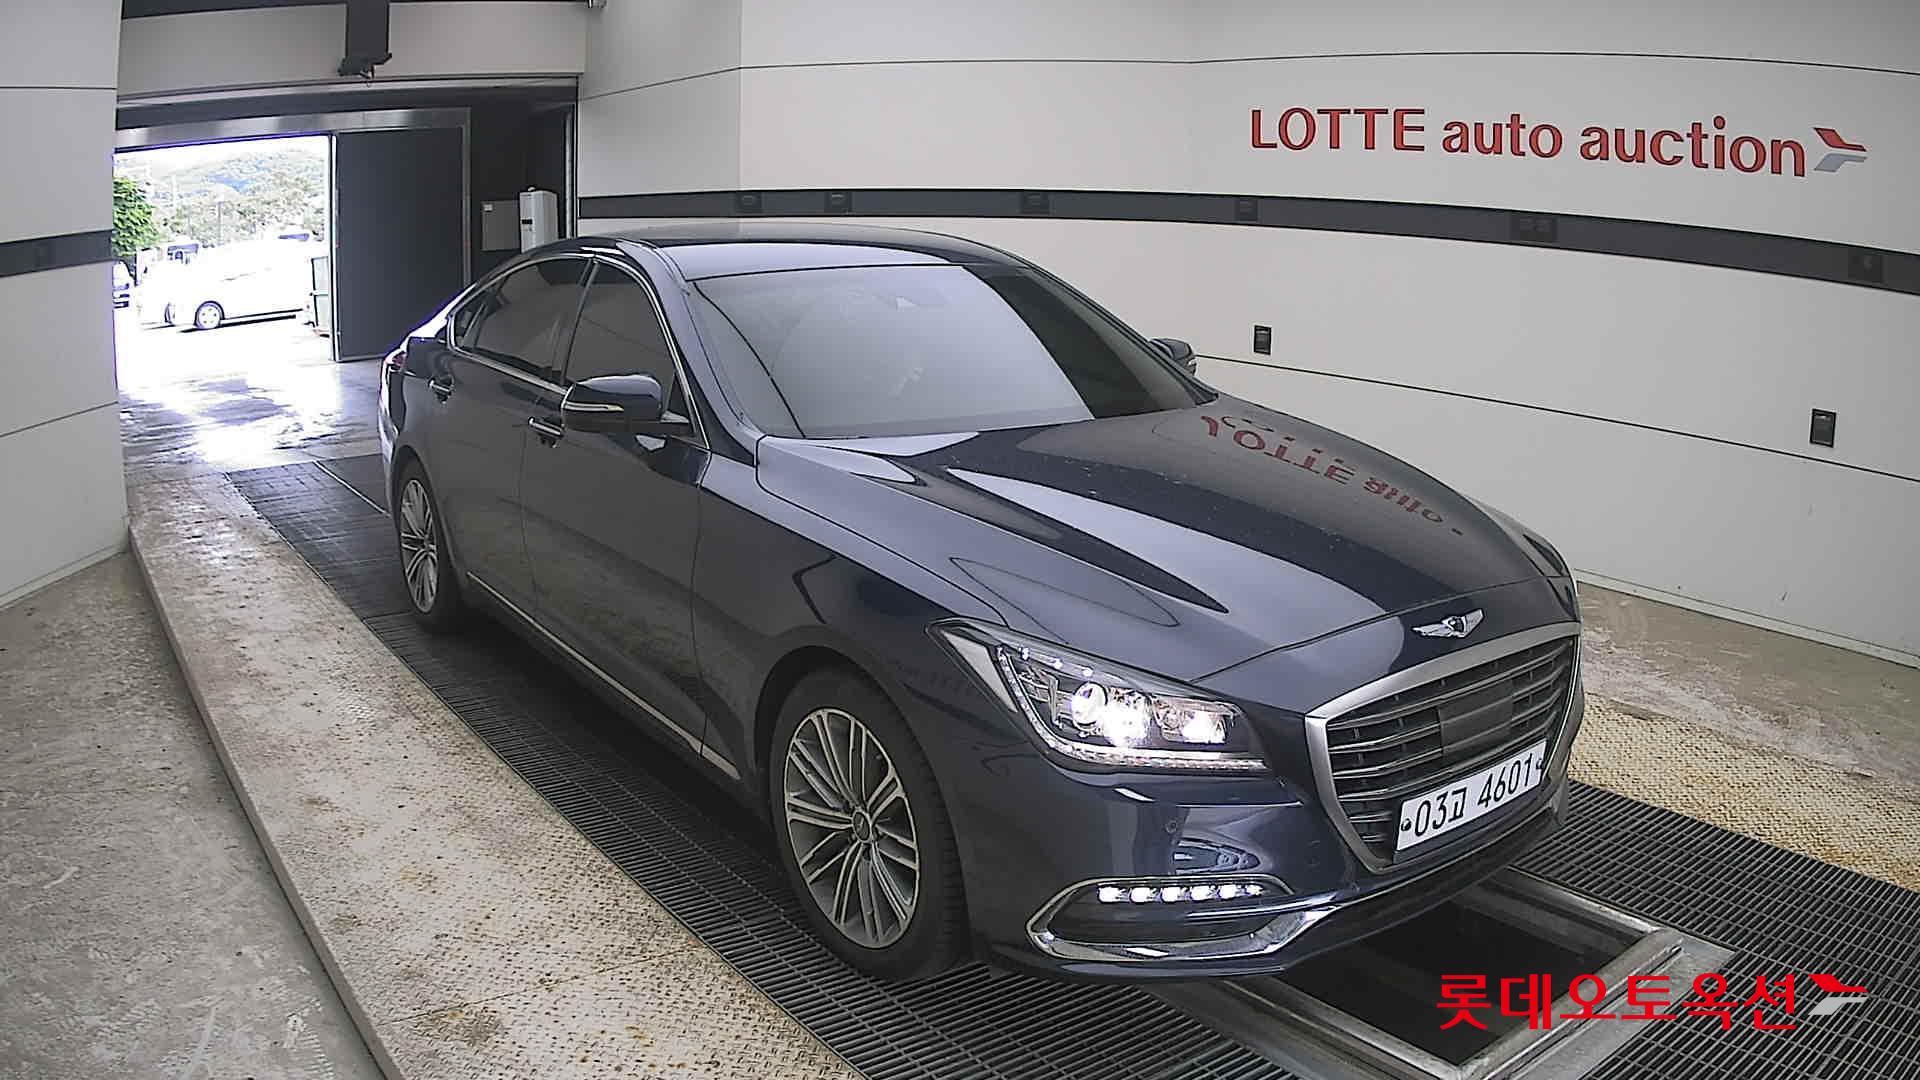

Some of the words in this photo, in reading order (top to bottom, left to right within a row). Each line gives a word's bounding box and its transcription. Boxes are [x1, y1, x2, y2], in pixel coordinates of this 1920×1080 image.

[1250, 107, 1425, 152] LOTTE
[1442, 113, 1563, 159] auto
[1579, 115, 1805, 177] auction
[1477, 752, 1533, 809] 4601
